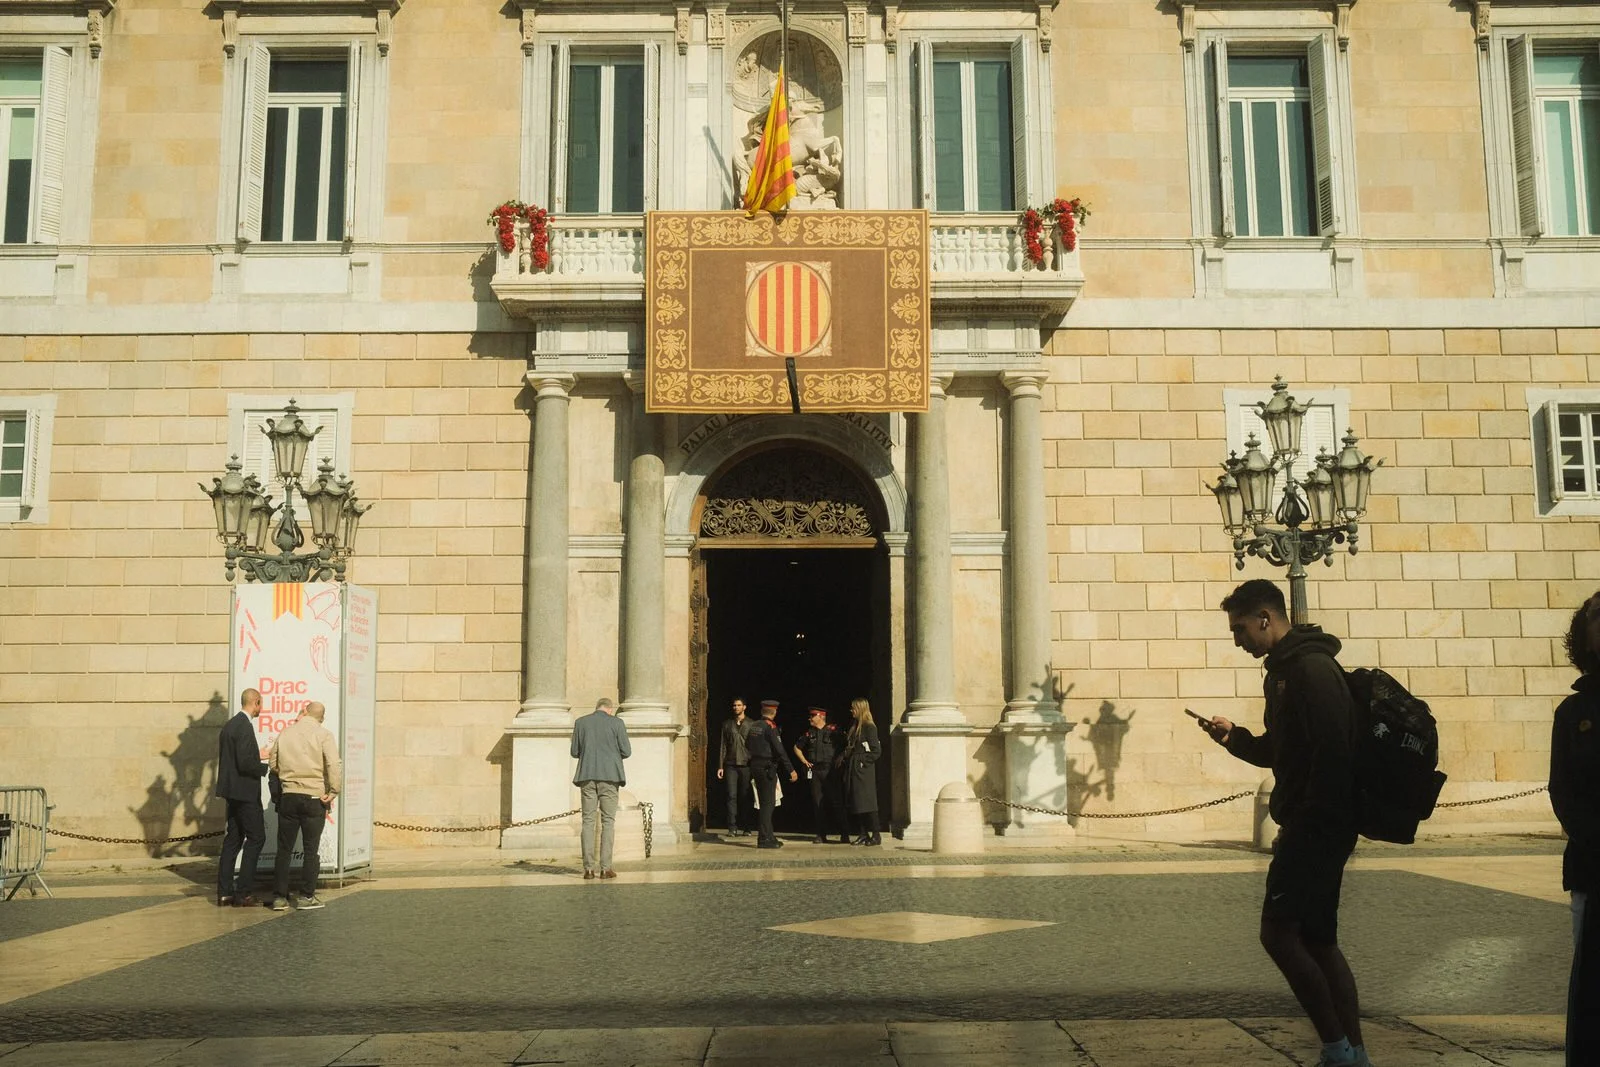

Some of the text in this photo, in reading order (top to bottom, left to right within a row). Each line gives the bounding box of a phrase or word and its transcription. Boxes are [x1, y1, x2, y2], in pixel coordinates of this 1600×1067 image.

[681, 416, 721, 453] PALAU
[259, 677, 308, 695] Drac
[258, 715, 298, 733] Ros
